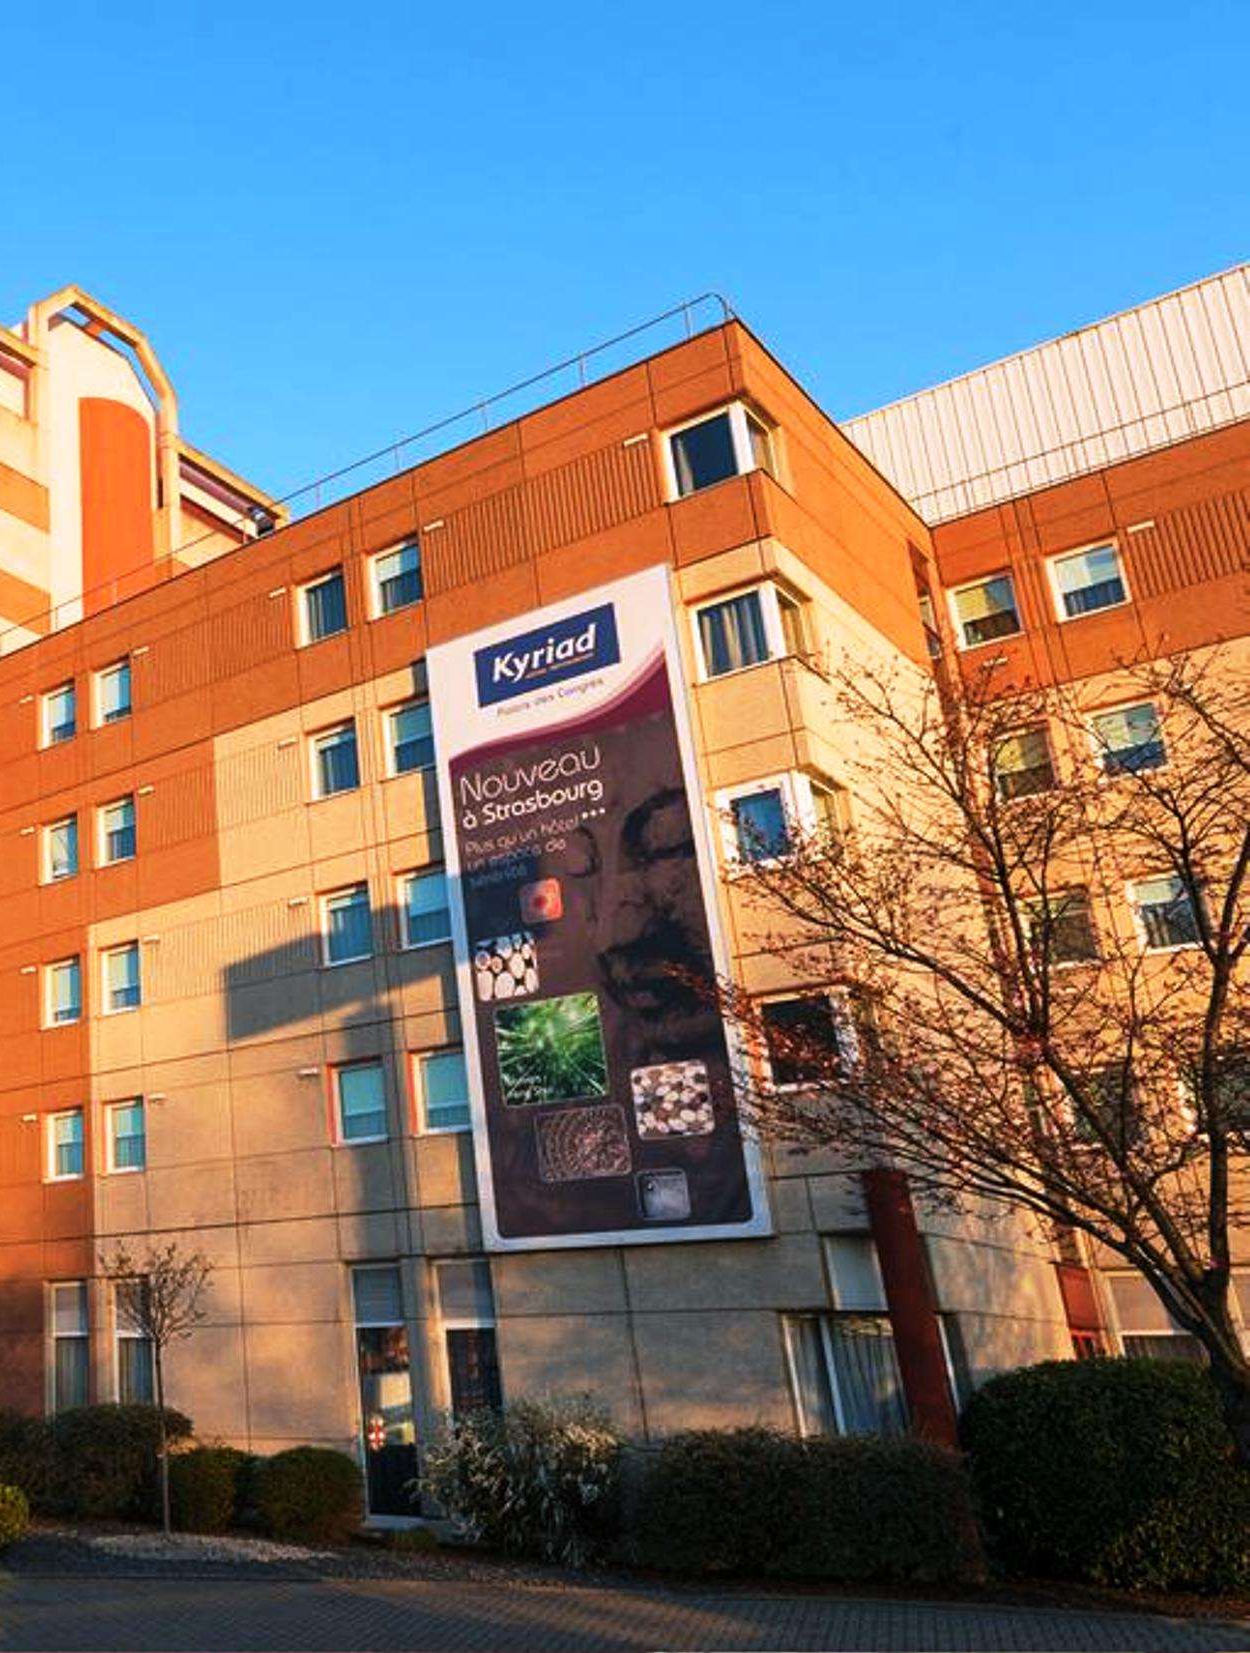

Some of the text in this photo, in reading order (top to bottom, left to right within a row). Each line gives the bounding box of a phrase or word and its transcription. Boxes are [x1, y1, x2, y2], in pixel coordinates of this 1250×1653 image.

[492, 622, 596, 683] Kyriad
[460, 746, 600, 805] Nouveau
[482, 779, 603, 825] Strasbourg
